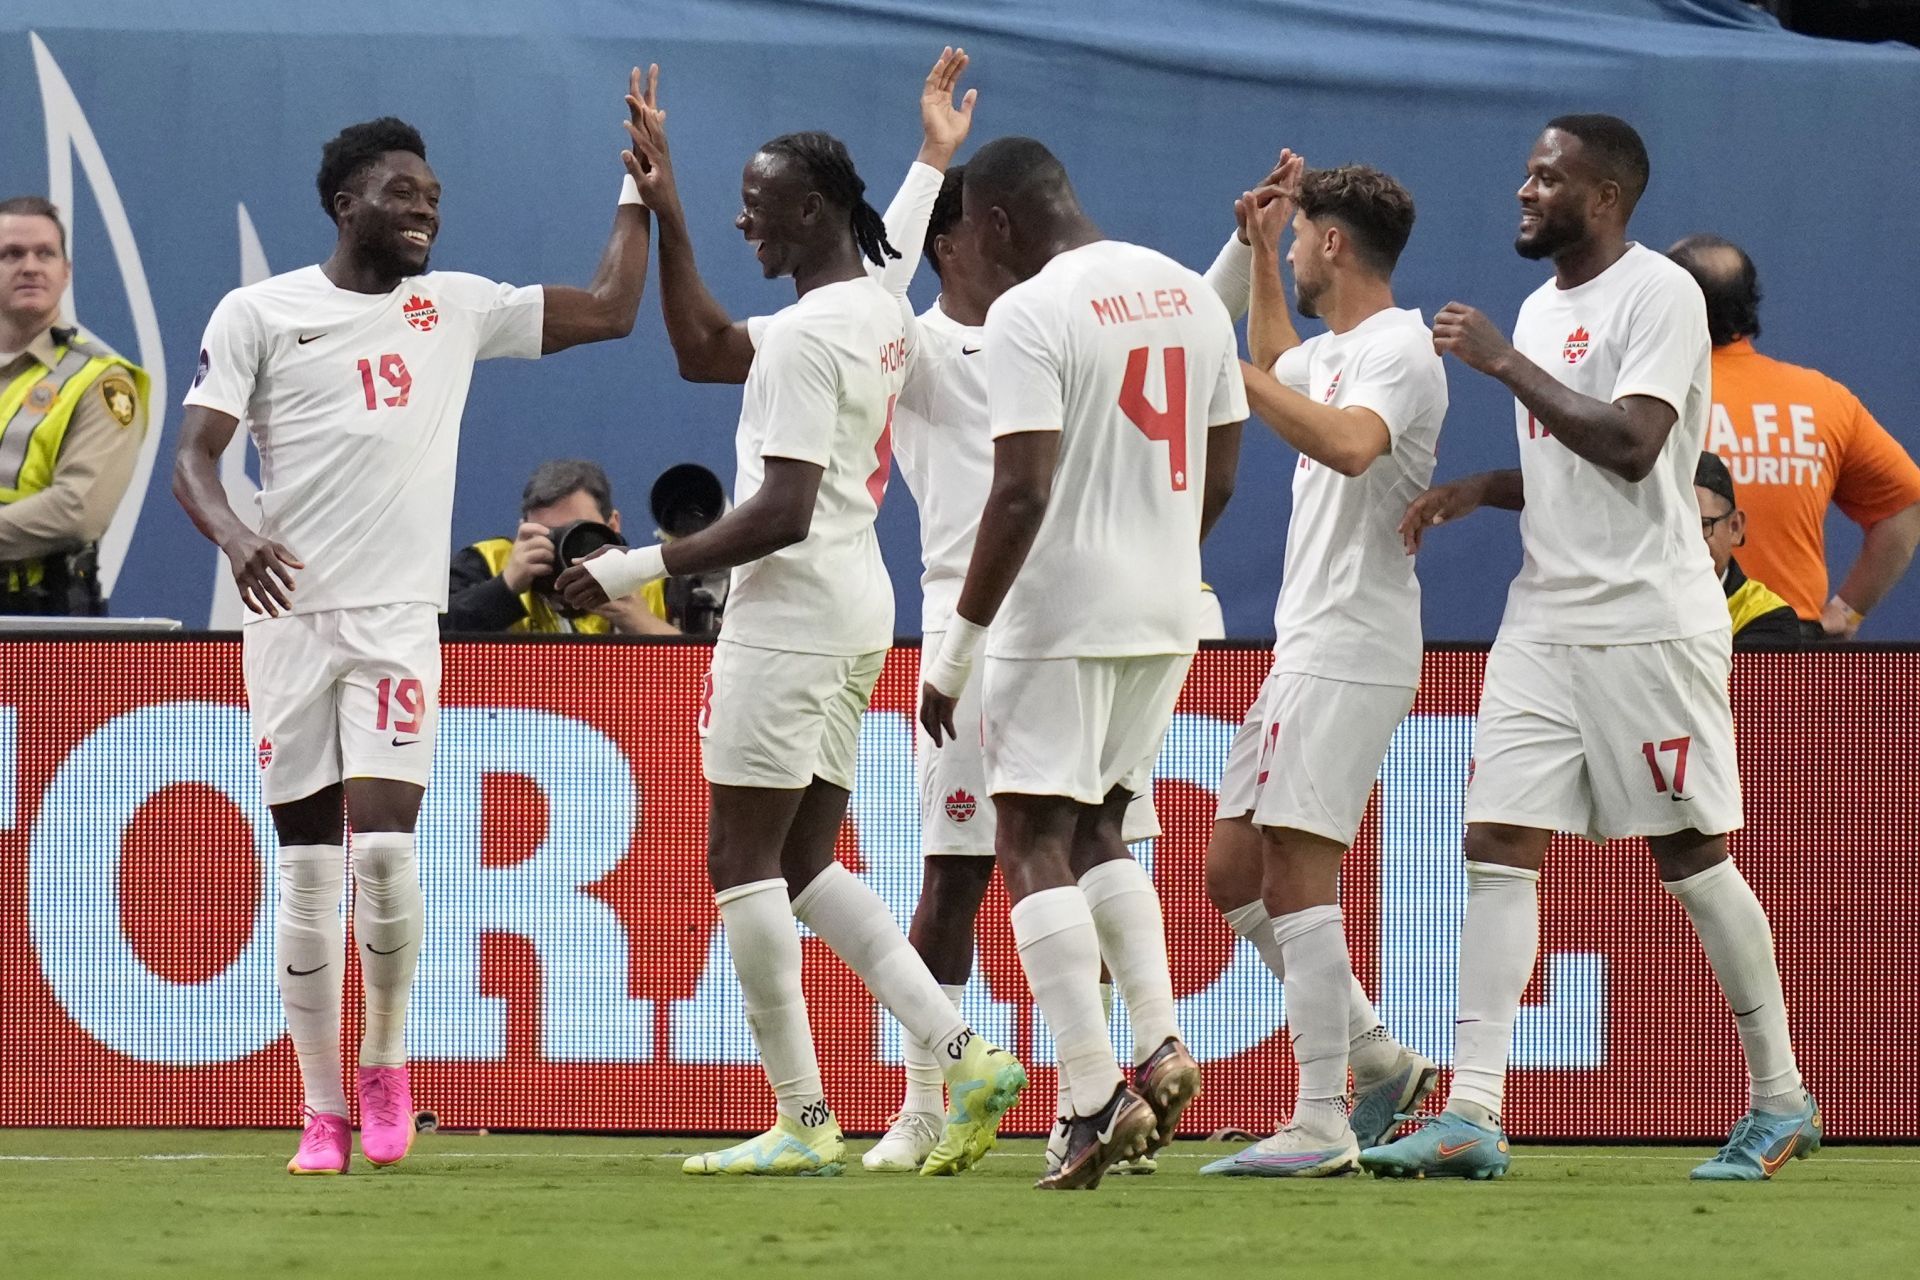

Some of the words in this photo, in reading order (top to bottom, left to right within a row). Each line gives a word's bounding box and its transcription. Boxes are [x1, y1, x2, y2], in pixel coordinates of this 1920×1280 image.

[404, 308, 437, 320] CANADA
[1090, 287, 1193, 326] MILLER
[1564, 341, 1588, 350] CANADA
[357, 353, 412, 411] 19
[1118, 346, 1187, 491] 4
[1720, 455, 1823, 488] URITY
[376, 678, 426, 734] 19
[1642, 736, 1691, 794] 17
